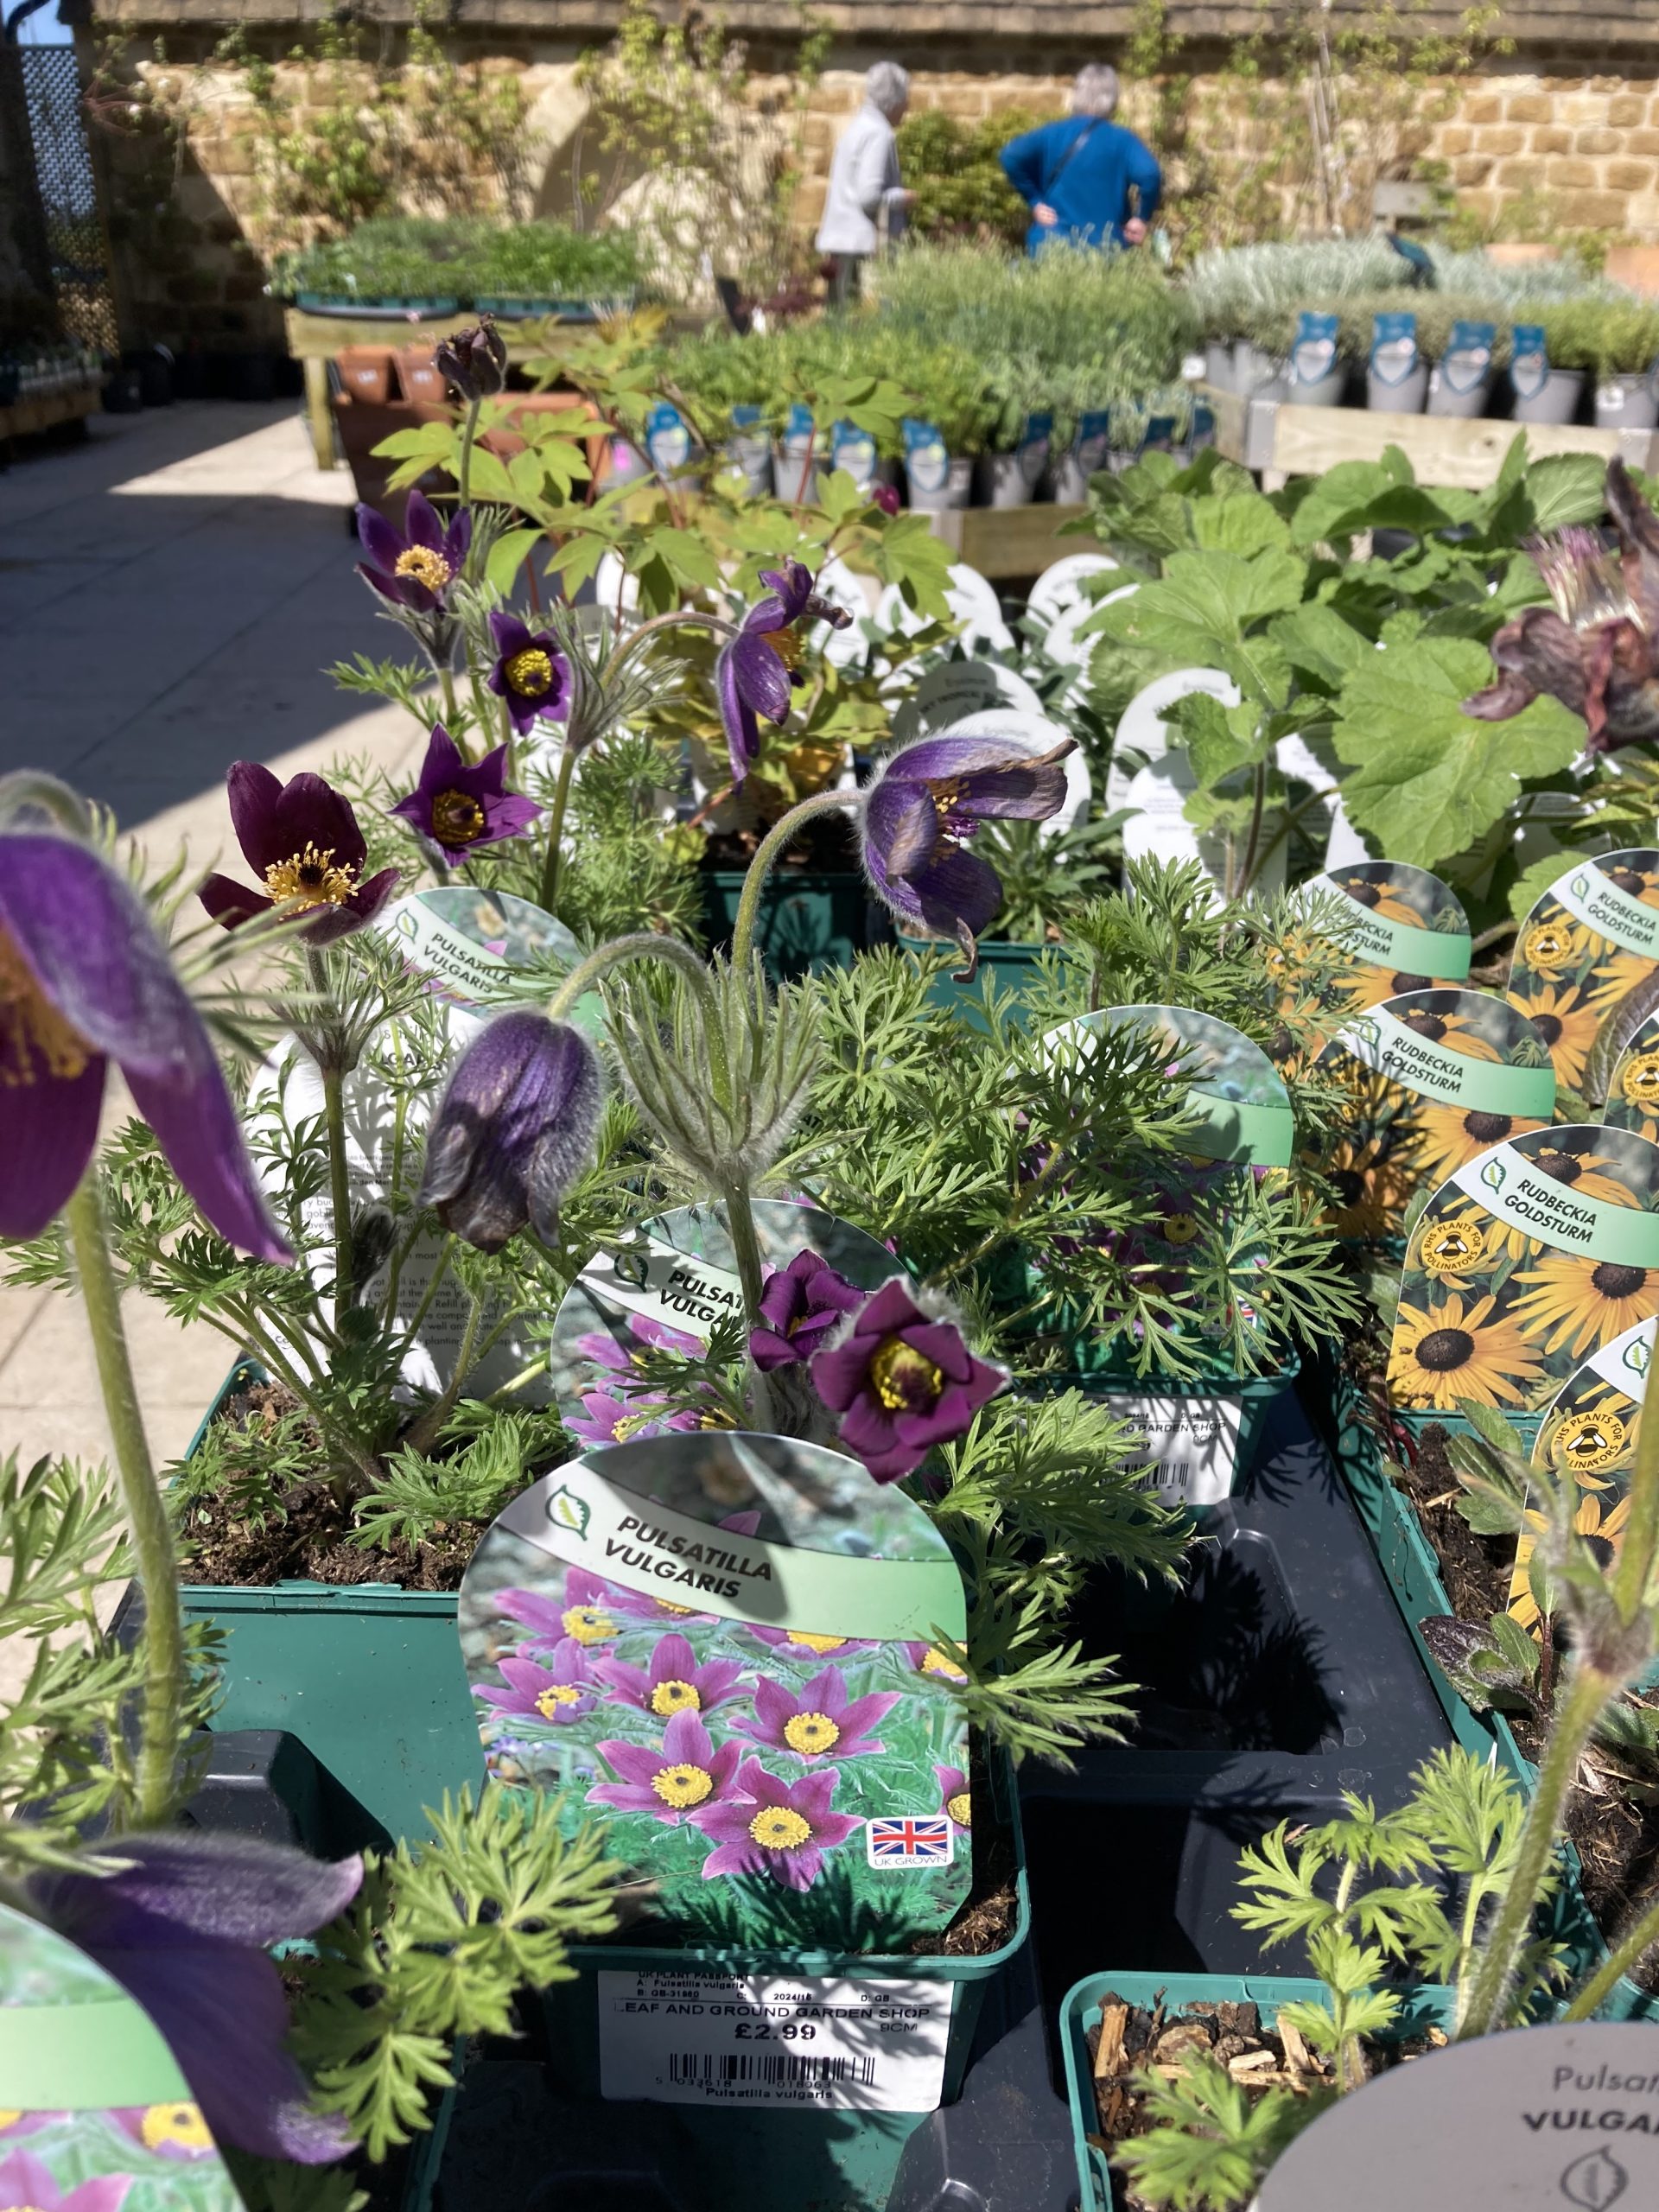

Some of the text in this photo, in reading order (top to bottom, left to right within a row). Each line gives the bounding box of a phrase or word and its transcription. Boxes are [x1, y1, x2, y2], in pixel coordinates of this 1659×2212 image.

[1588, 904, 1653, 944] GOLDSTURM
[1599, 892, 1656, 931] RUDBECKIA
[424, 944, 493, 994] VULGARIS
[1382, 1051, 1462, 1093] GOLDSTURM
[1392, 1037, 1464, 1077] RUDBECKIA
[1504, 1195, 1593, 1243] GOLDSTURM
[1517, 1179, 1597, 1226] RUDBECKIA
[1424, 1222, 1481, 1249] RHS PLANTS FOR
[1425, 1251, 1478, 1270] POLLINATORS
[1138, 1423, 1188, 1433] GARDEN
[1192, 1422, 1227, 1431] SHOP
[1570, 1413, 1613, 1427] PLANTS
[1611, 1423, 1622, 1440] FOR
[617, 1516, 772, 1581] PULSATILLA
[605, 1538, 741, 1598] VULGARIS
[874, 1855, 947, 1866] UK GROWN
[665, 2003, 704, 2015] AND
[709, 2005, 790, 2017] GROUND
[795, 2007, 873, 2018] GARDEN
[879, 2008, 931, 2018] SHOP
[734, 2023, 817, 2040] £2.99
[880, 2023, 918, 2032] 9CM
[705, 2088, 833, 2101] Pulsatilla vulgaris
